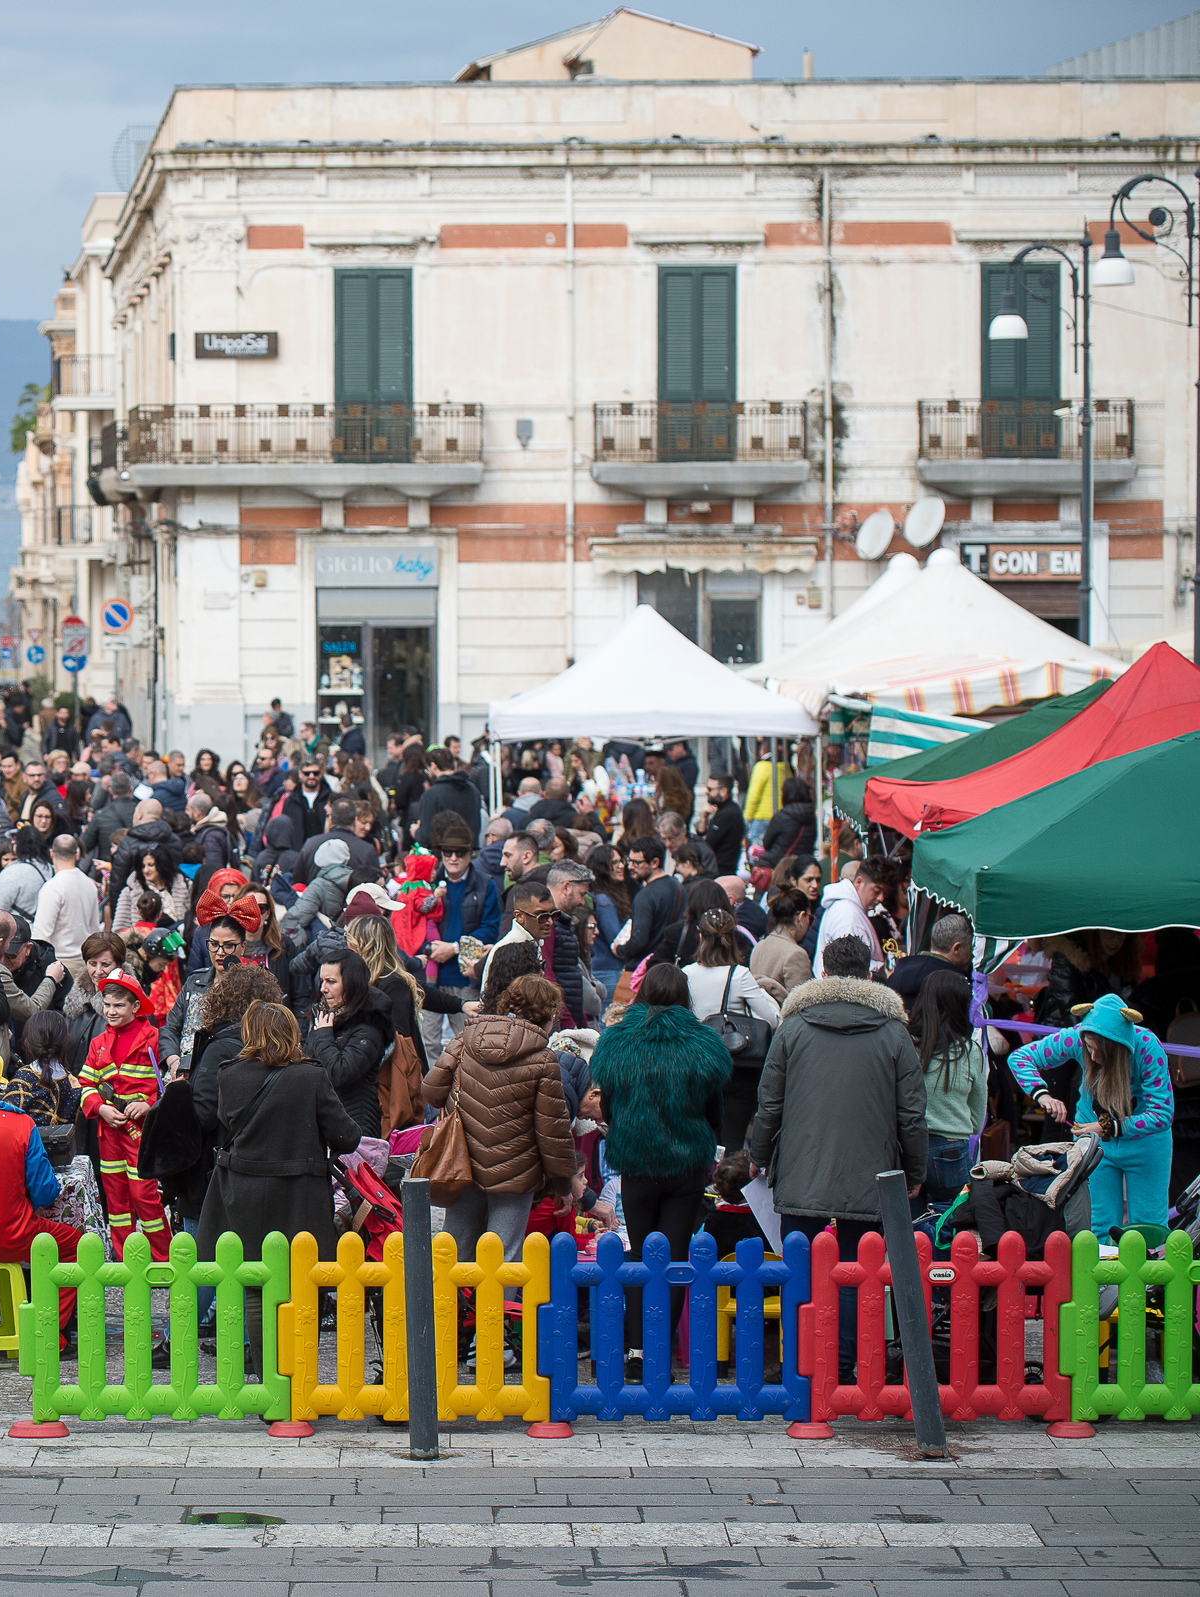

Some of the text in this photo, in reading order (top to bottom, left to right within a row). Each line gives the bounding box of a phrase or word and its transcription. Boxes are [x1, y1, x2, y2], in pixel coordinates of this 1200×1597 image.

[203, 333, 269, 355] UnipolSai
[317, 553, 434, 581] GIGLIO baby
[964, 545, 987, 573] T
